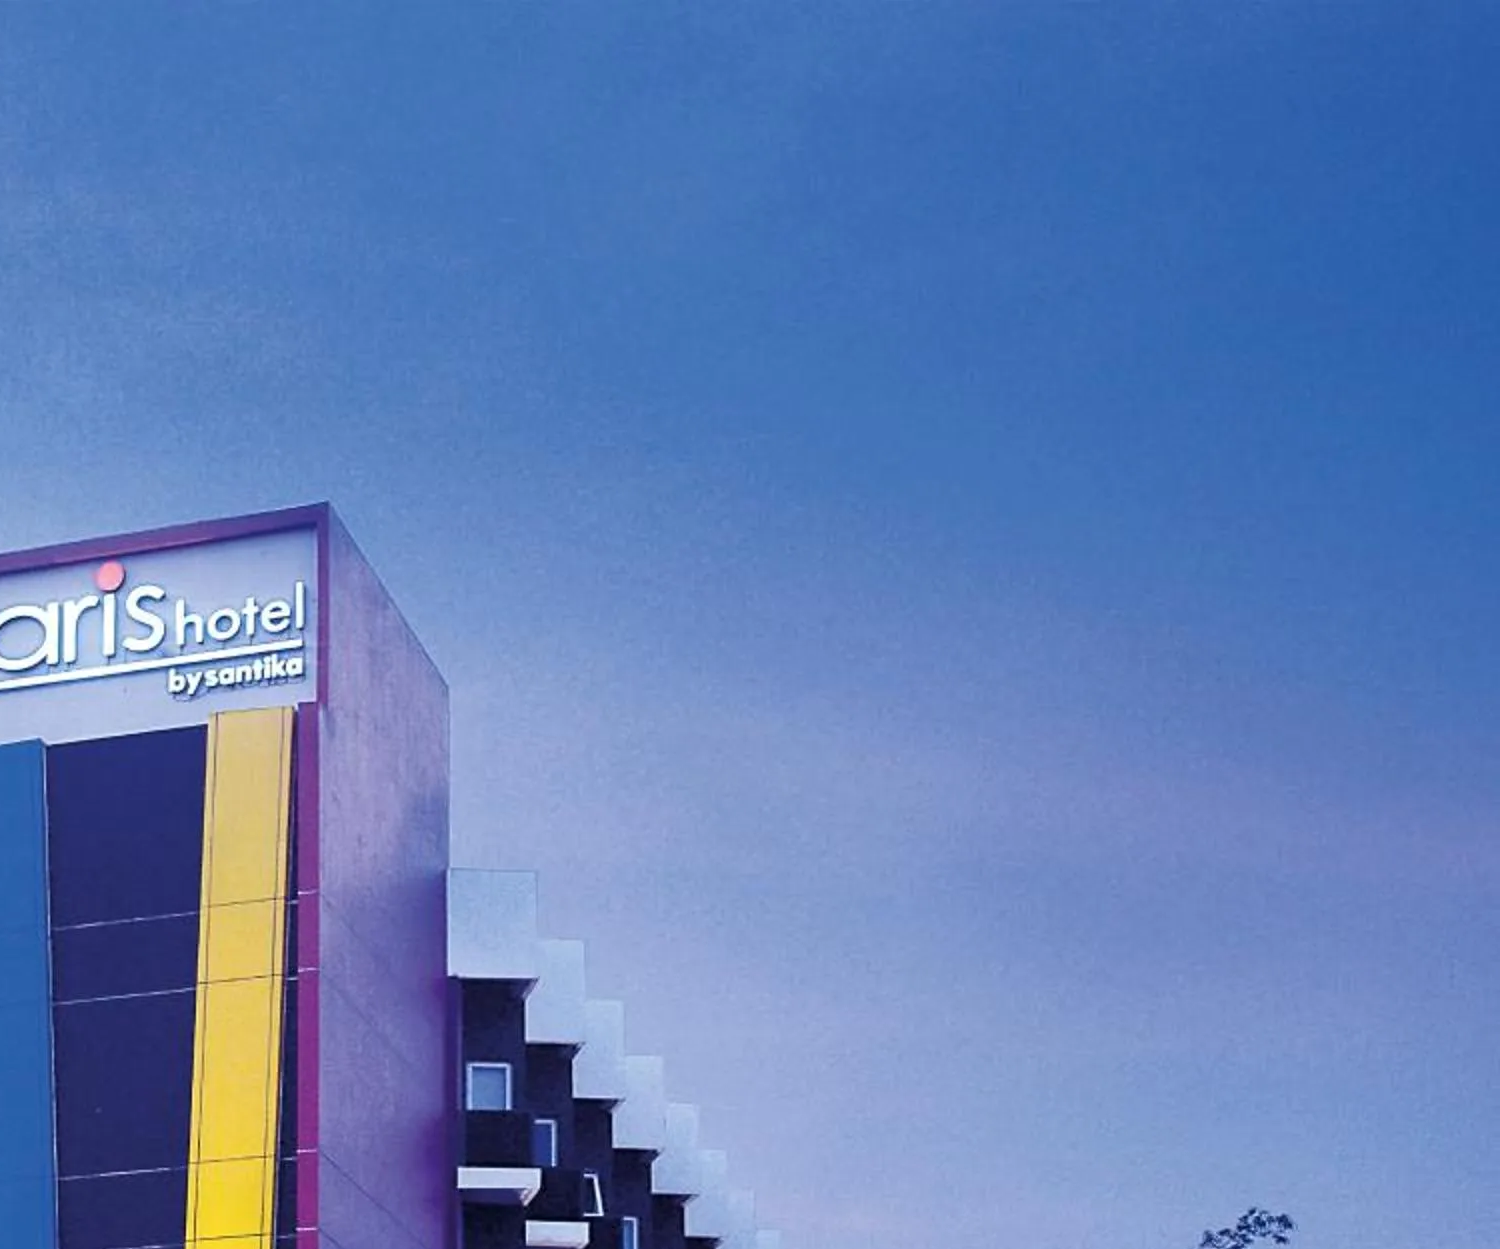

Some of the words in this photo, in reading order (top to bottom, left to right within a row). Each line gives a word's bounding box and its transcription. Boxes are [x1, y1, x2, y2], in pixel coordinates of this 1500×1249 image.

[175, 581, 304, 645] hotel
[168, 668, 202, 695] by
[204, 654, 304, 688] santika
